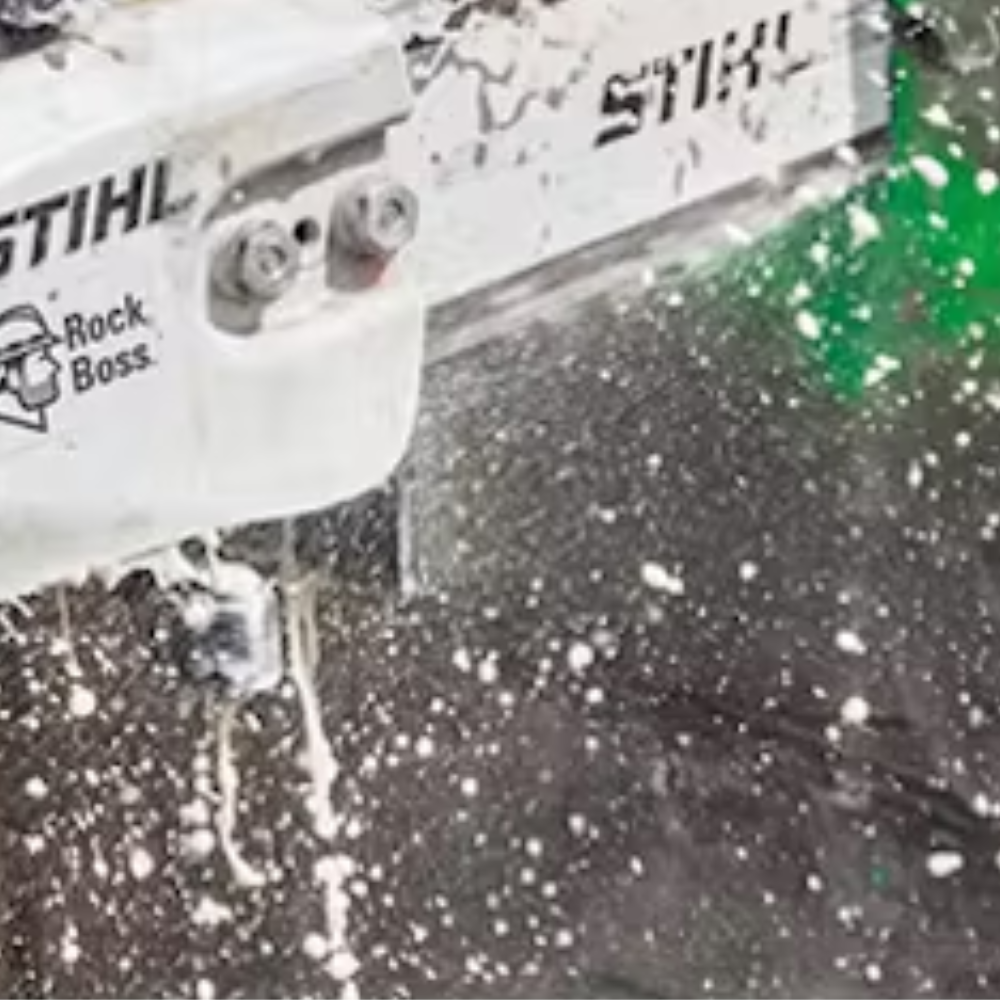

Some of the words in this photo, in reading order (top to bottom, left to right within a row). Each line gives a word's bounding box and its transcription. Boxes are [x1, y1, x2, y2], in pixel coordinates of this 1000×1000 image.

[594, 11, 812, 147] STIHL
[64, 294, 149, 349] Rock
[71, 343, 150, 393] Boss
